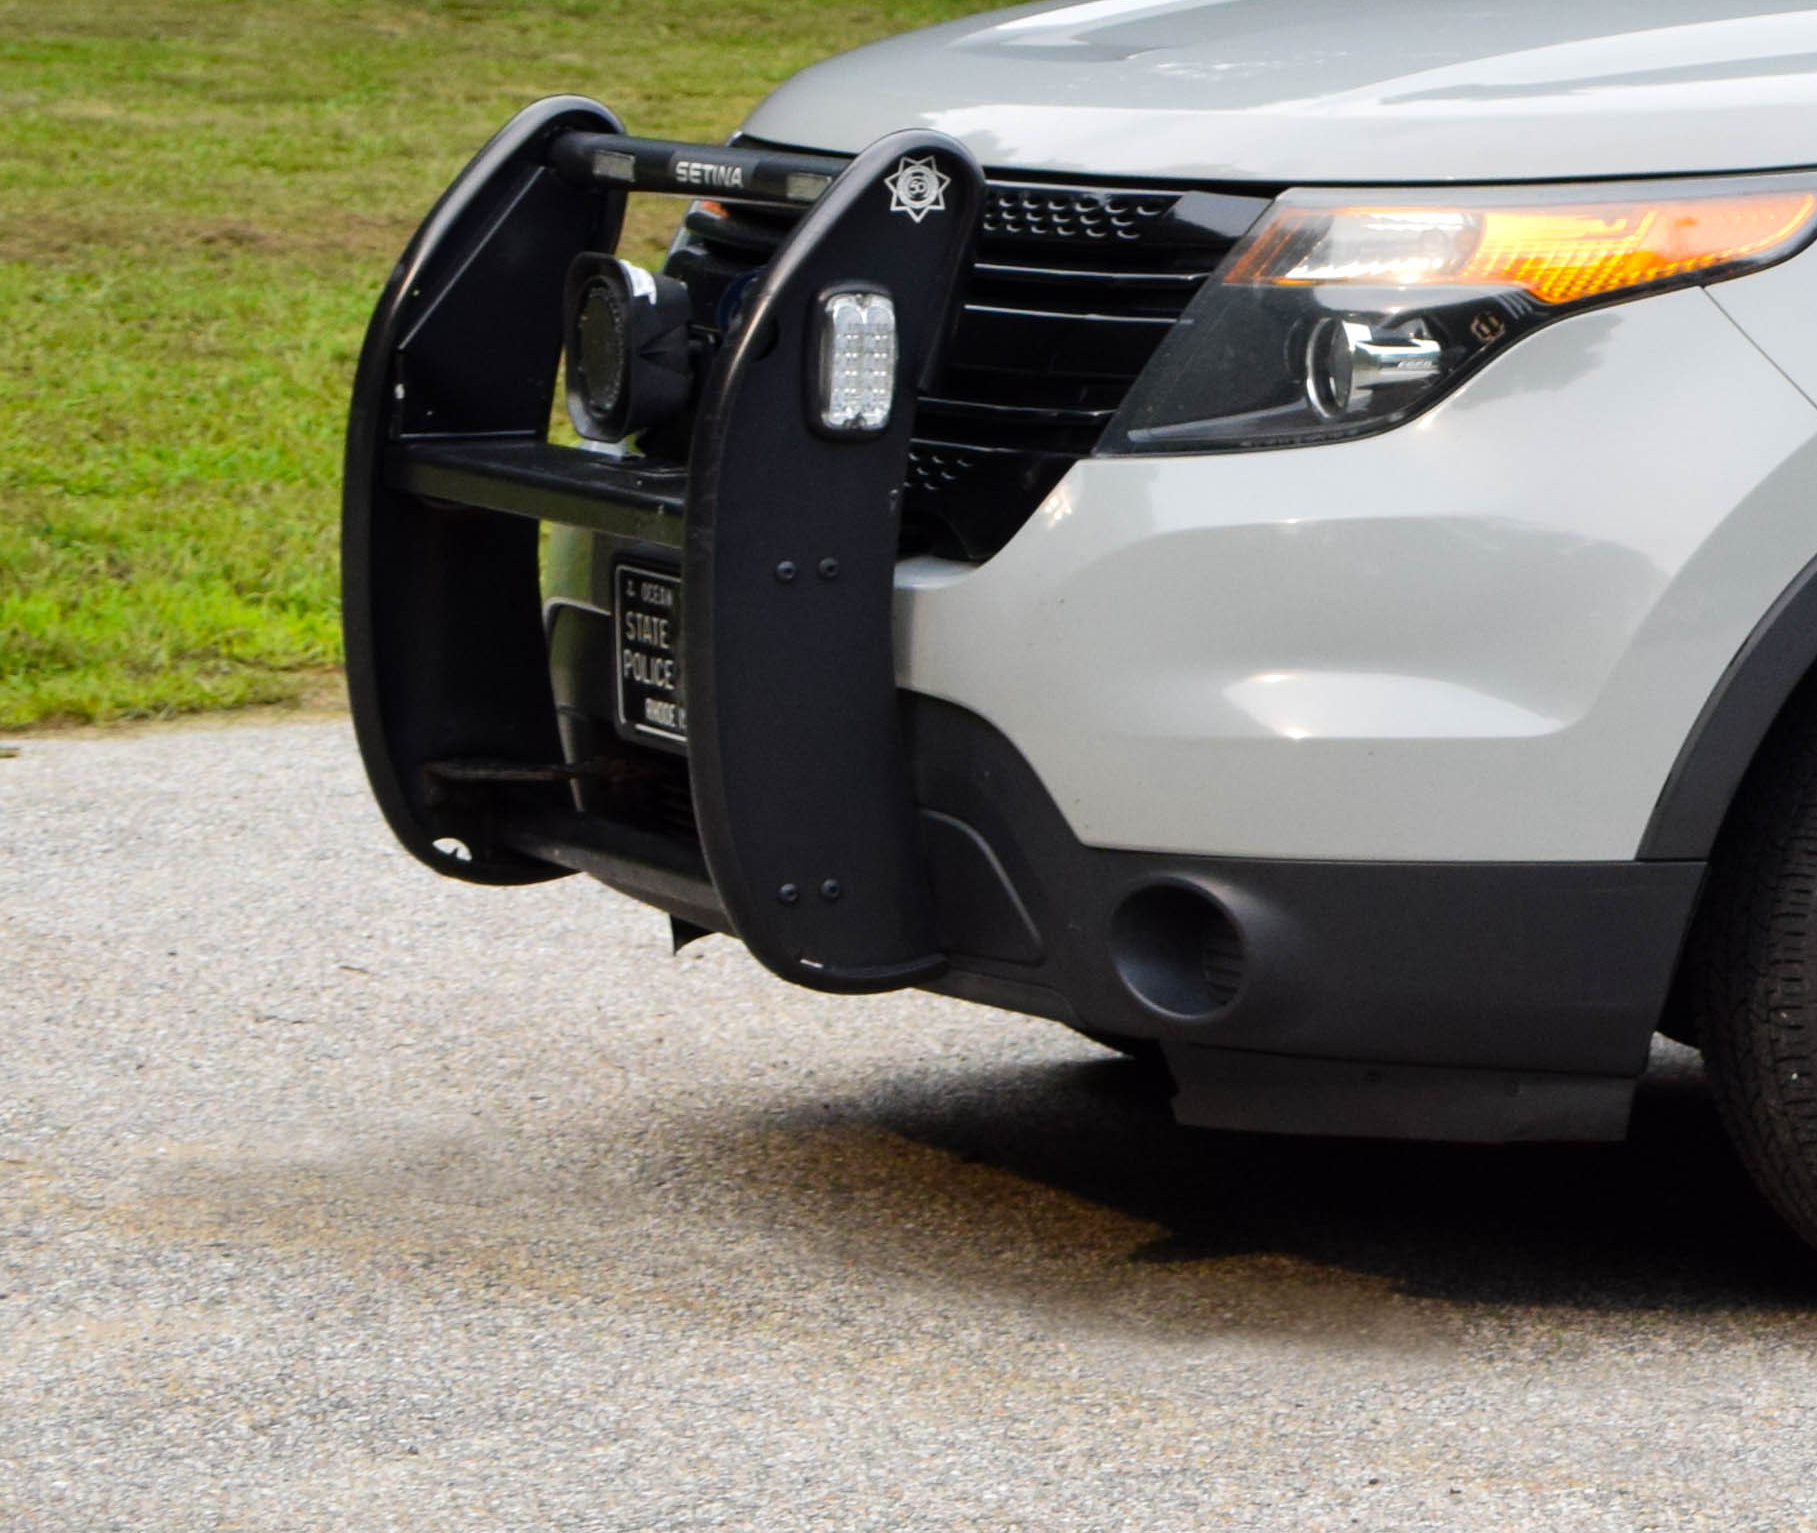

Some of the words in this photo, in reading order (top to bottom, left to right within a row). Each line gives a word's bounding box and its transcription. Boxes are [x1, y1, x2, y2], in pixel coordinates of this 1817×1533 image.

[676, 161, 743, 187] SETINA
[625, 611, 670, 649] STATE
[623, 649, 675, 690] POLICE
